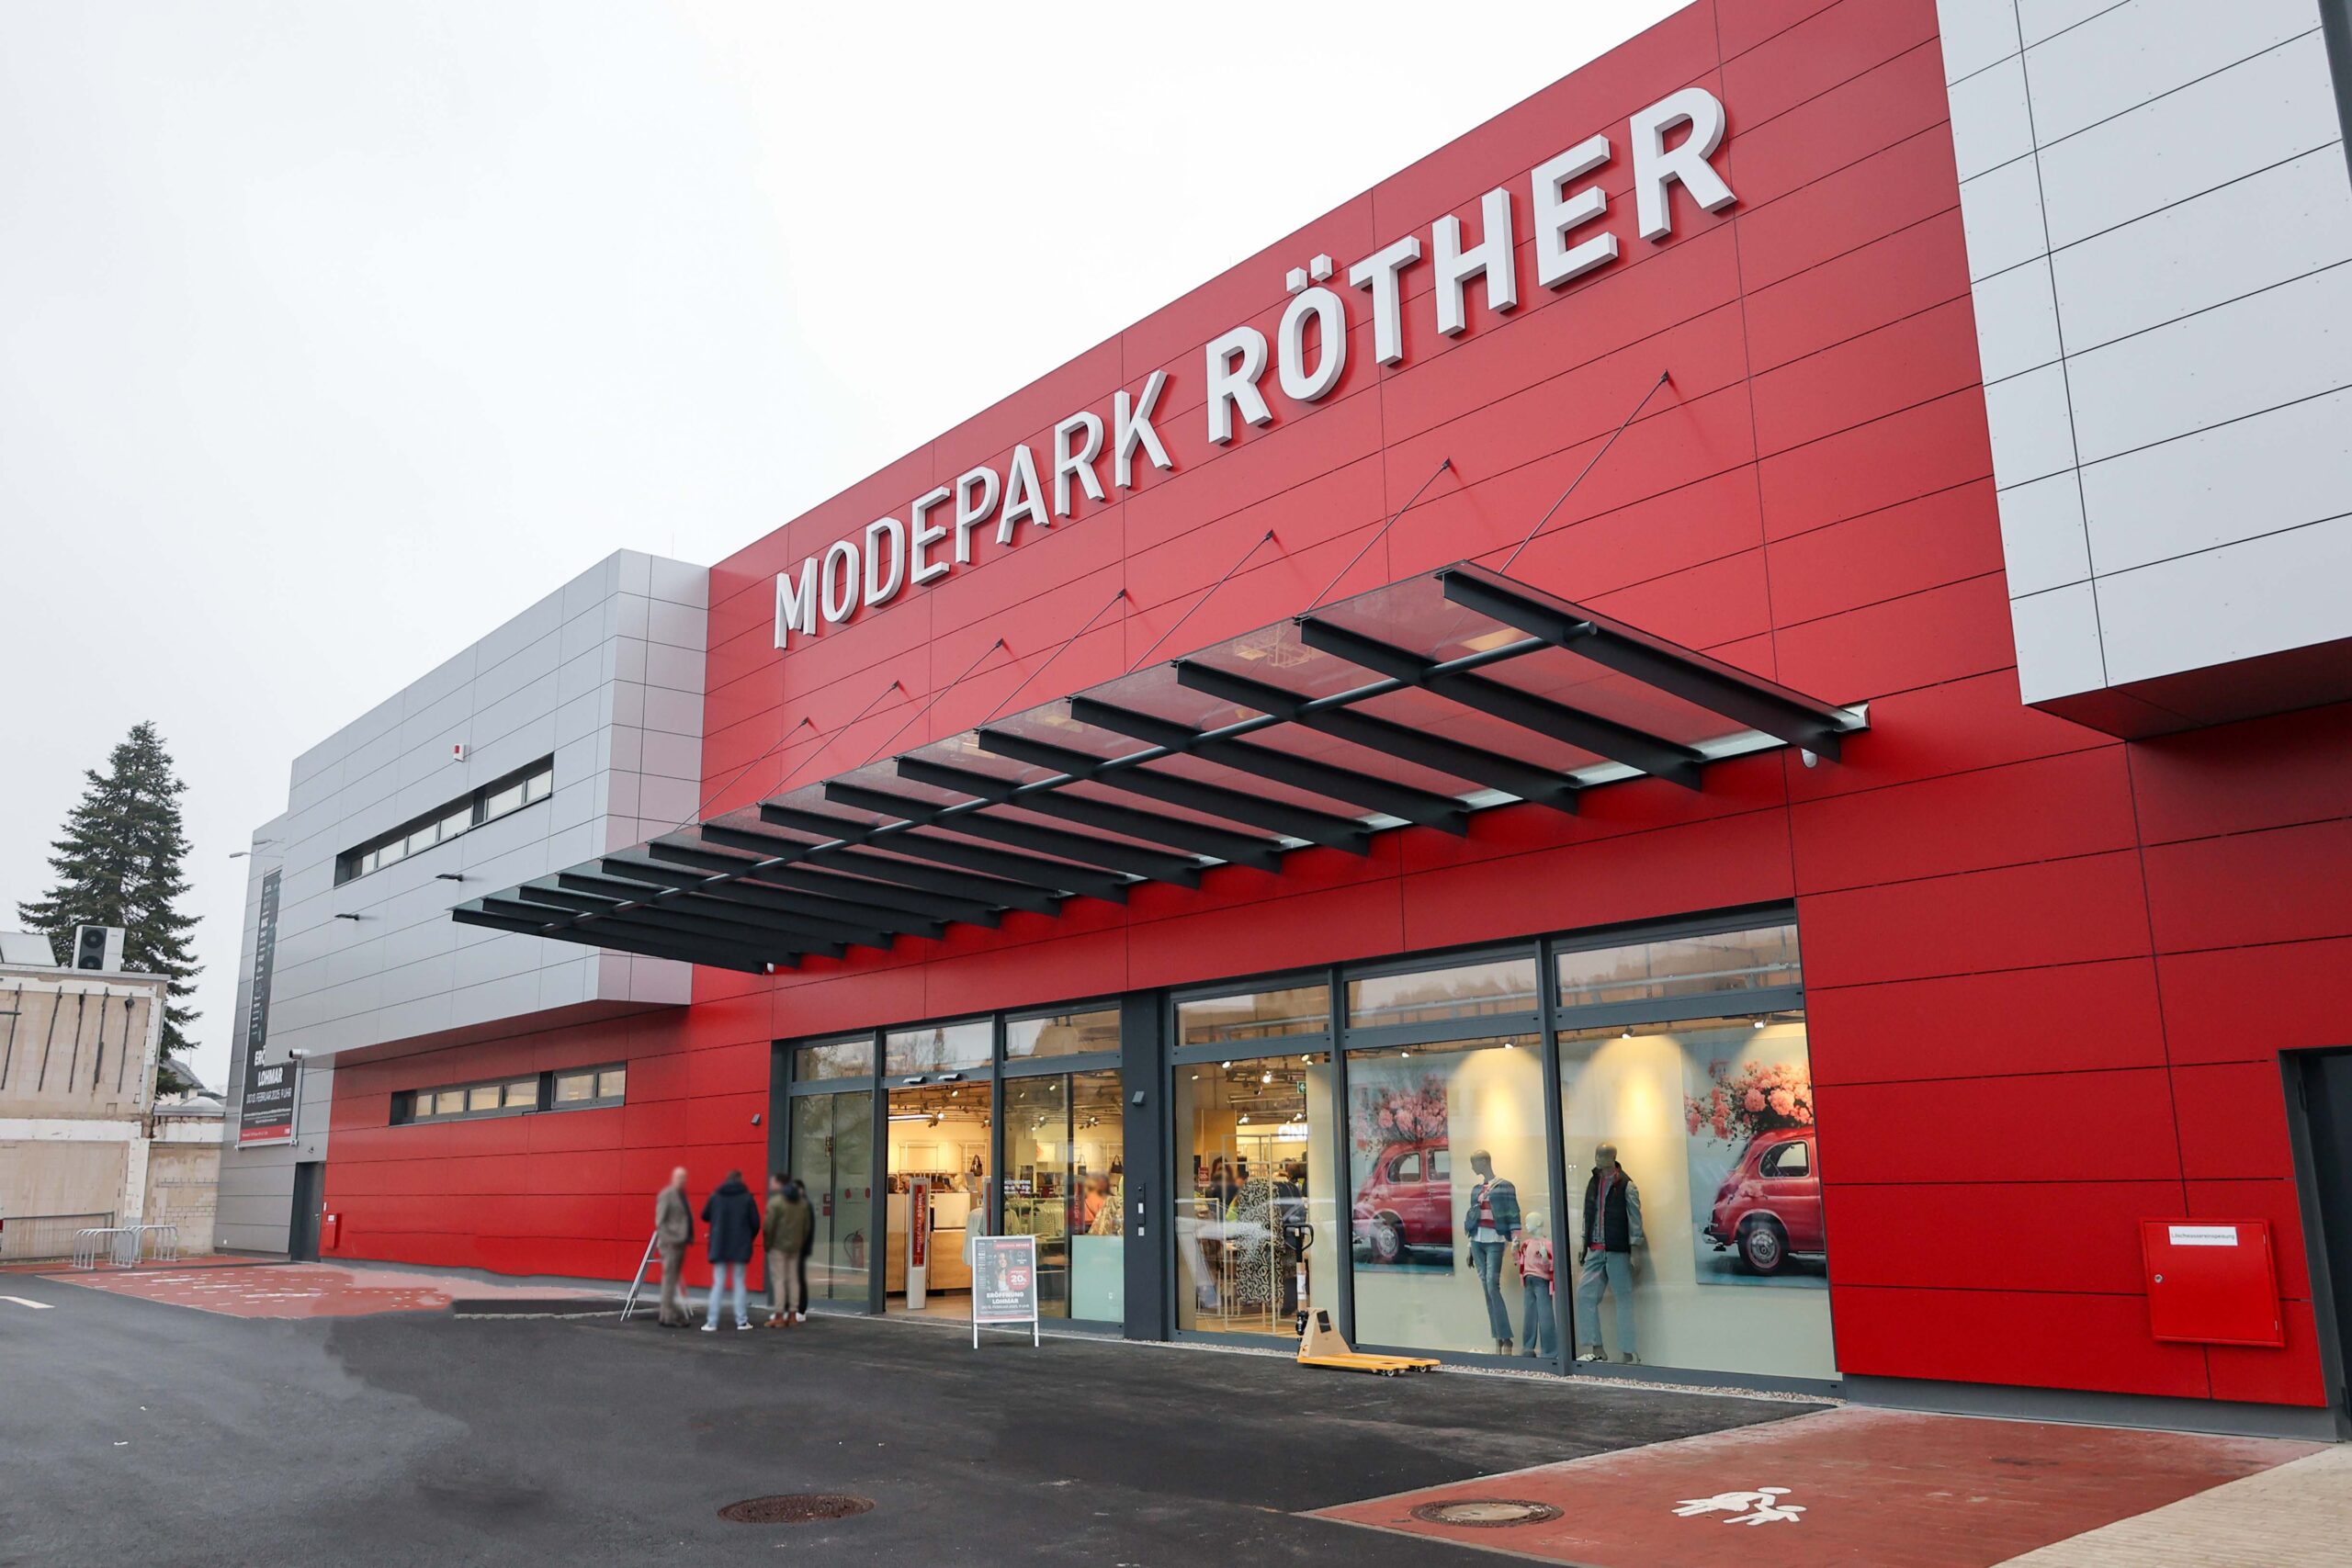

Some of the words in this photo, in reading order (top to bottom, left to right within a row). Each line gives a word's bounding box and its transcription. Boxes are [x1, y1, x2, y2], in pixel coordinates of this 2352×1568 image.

[773, 369, 1173, 650] MODEPARK
[1205, 87, 1738, 446] RÖTHER
[257, 1066, 283, 1088] LOHMAR
